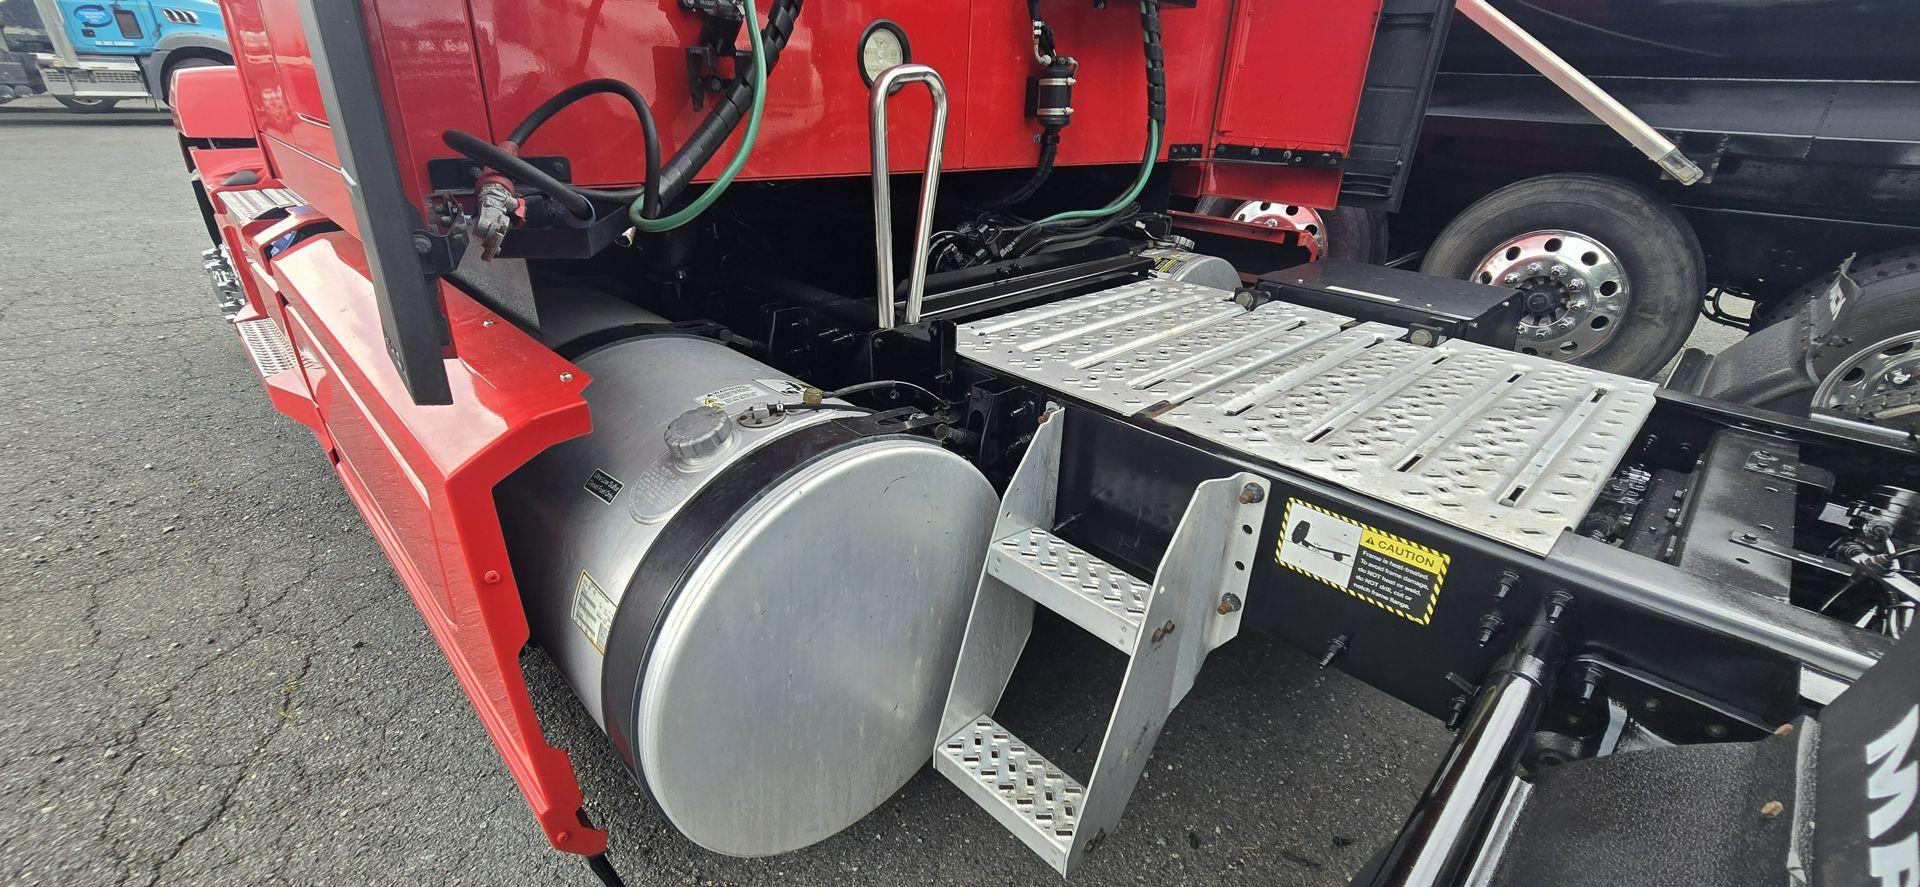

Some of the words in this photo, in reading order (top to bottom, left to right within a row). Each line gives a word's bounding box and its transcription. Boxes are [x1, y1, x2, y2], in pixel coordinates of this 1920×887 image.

[1362, 551, 1381, 561] Frame
[1383, 556, 1390, 564] is
[1389, 560, 1429, 581] heat-treated.
[1378, 540, 1435, 567] CAUTION
[1358, 567, 1366, 575] do
[1367, 569, 1381, 580] NOT
[1382, 574, 1396, 586] heat
[1397, 581, 1404, 589] or
[1360, 559, 1368, 567] To
[1369, 561, 1385, 572] avoid
[1385, 567, 1402, 580] frame
[1353, 582, 1370, 593] notch
[1371, 588, 1388, 600] frame
[1390, 595, 1410, 610] flange.
[1356, 575, 1364, 583] do
[1365, 578, 1379, 588] NOT
[1393, 589, 1404, 600] cut
[1405, 594, 1413, 602] or
